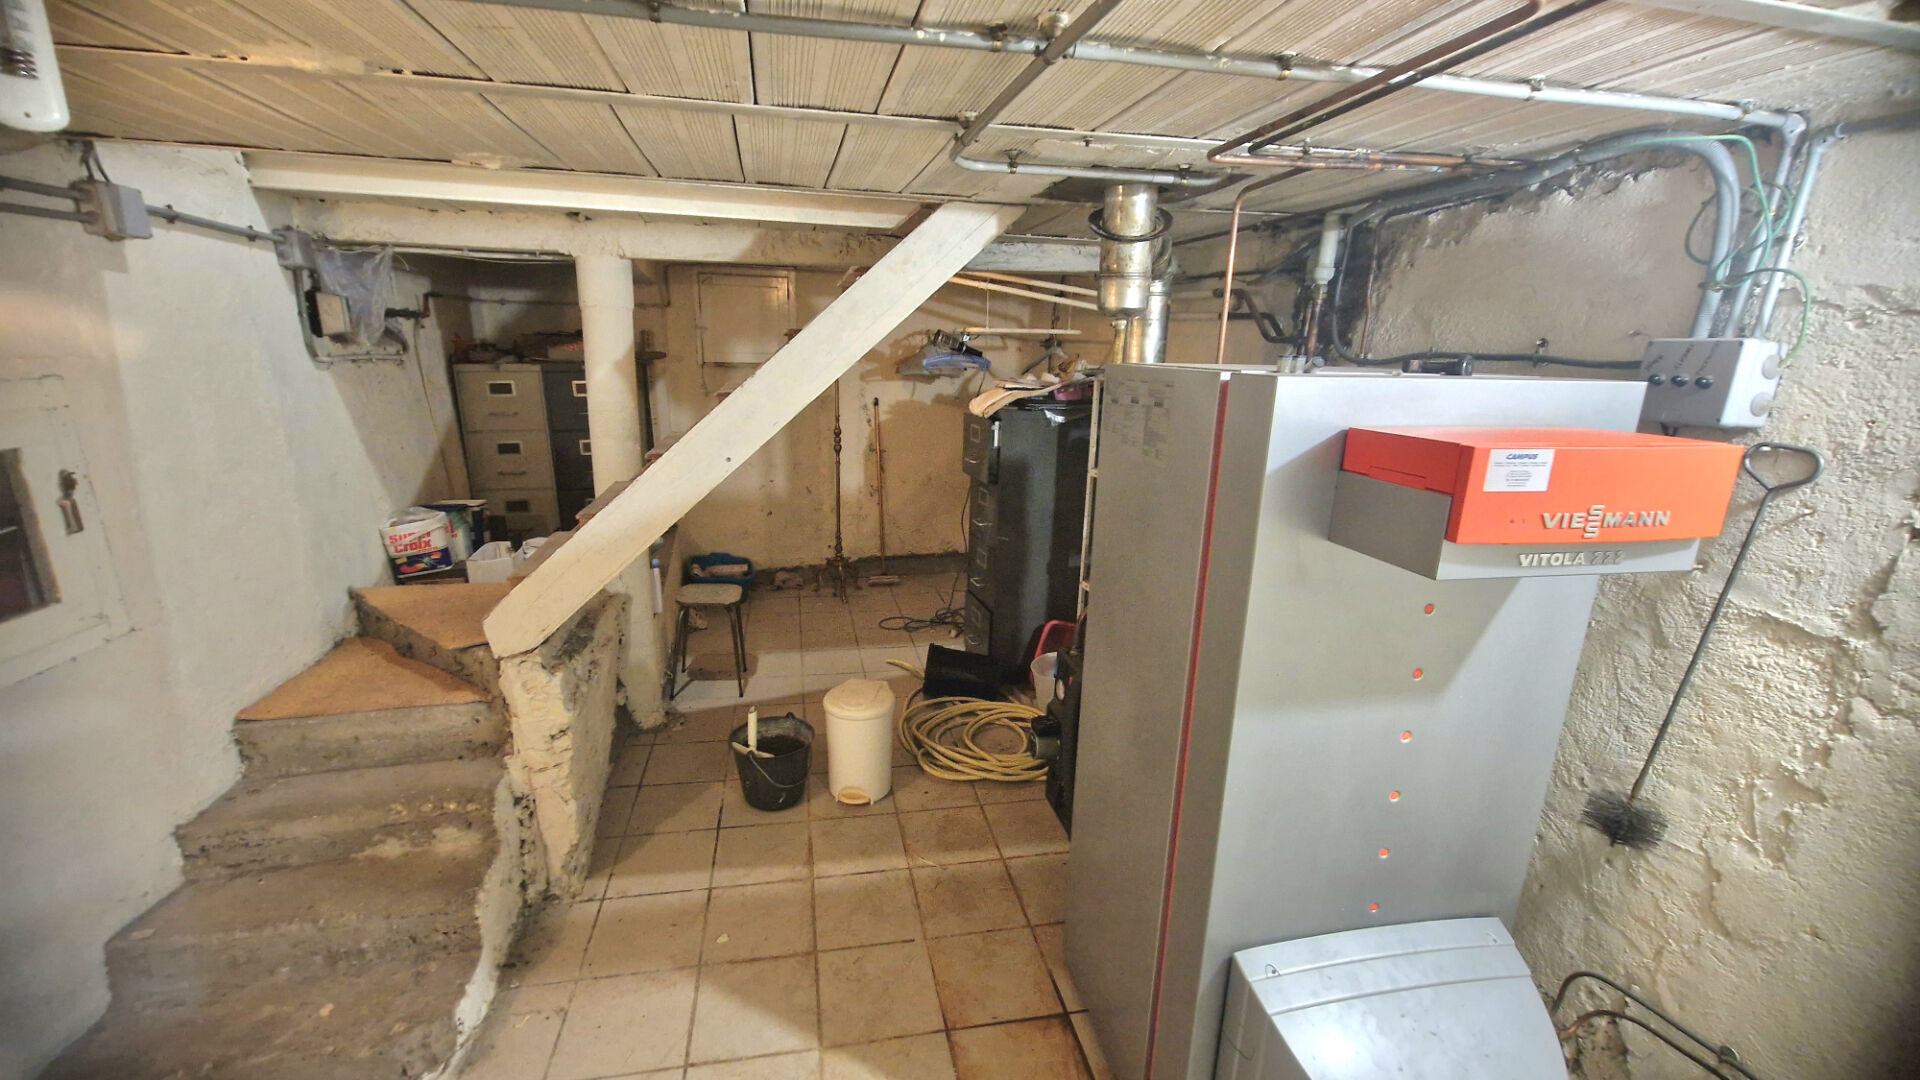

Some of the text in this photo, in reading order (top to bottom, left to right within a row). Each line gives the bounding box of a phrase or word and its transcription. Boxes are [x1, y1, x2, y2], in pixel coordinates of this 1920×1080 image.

[1541, 504, 1671, 539] VIESSMANN
[1518, 550, 1626, 567] VITOLA 222
